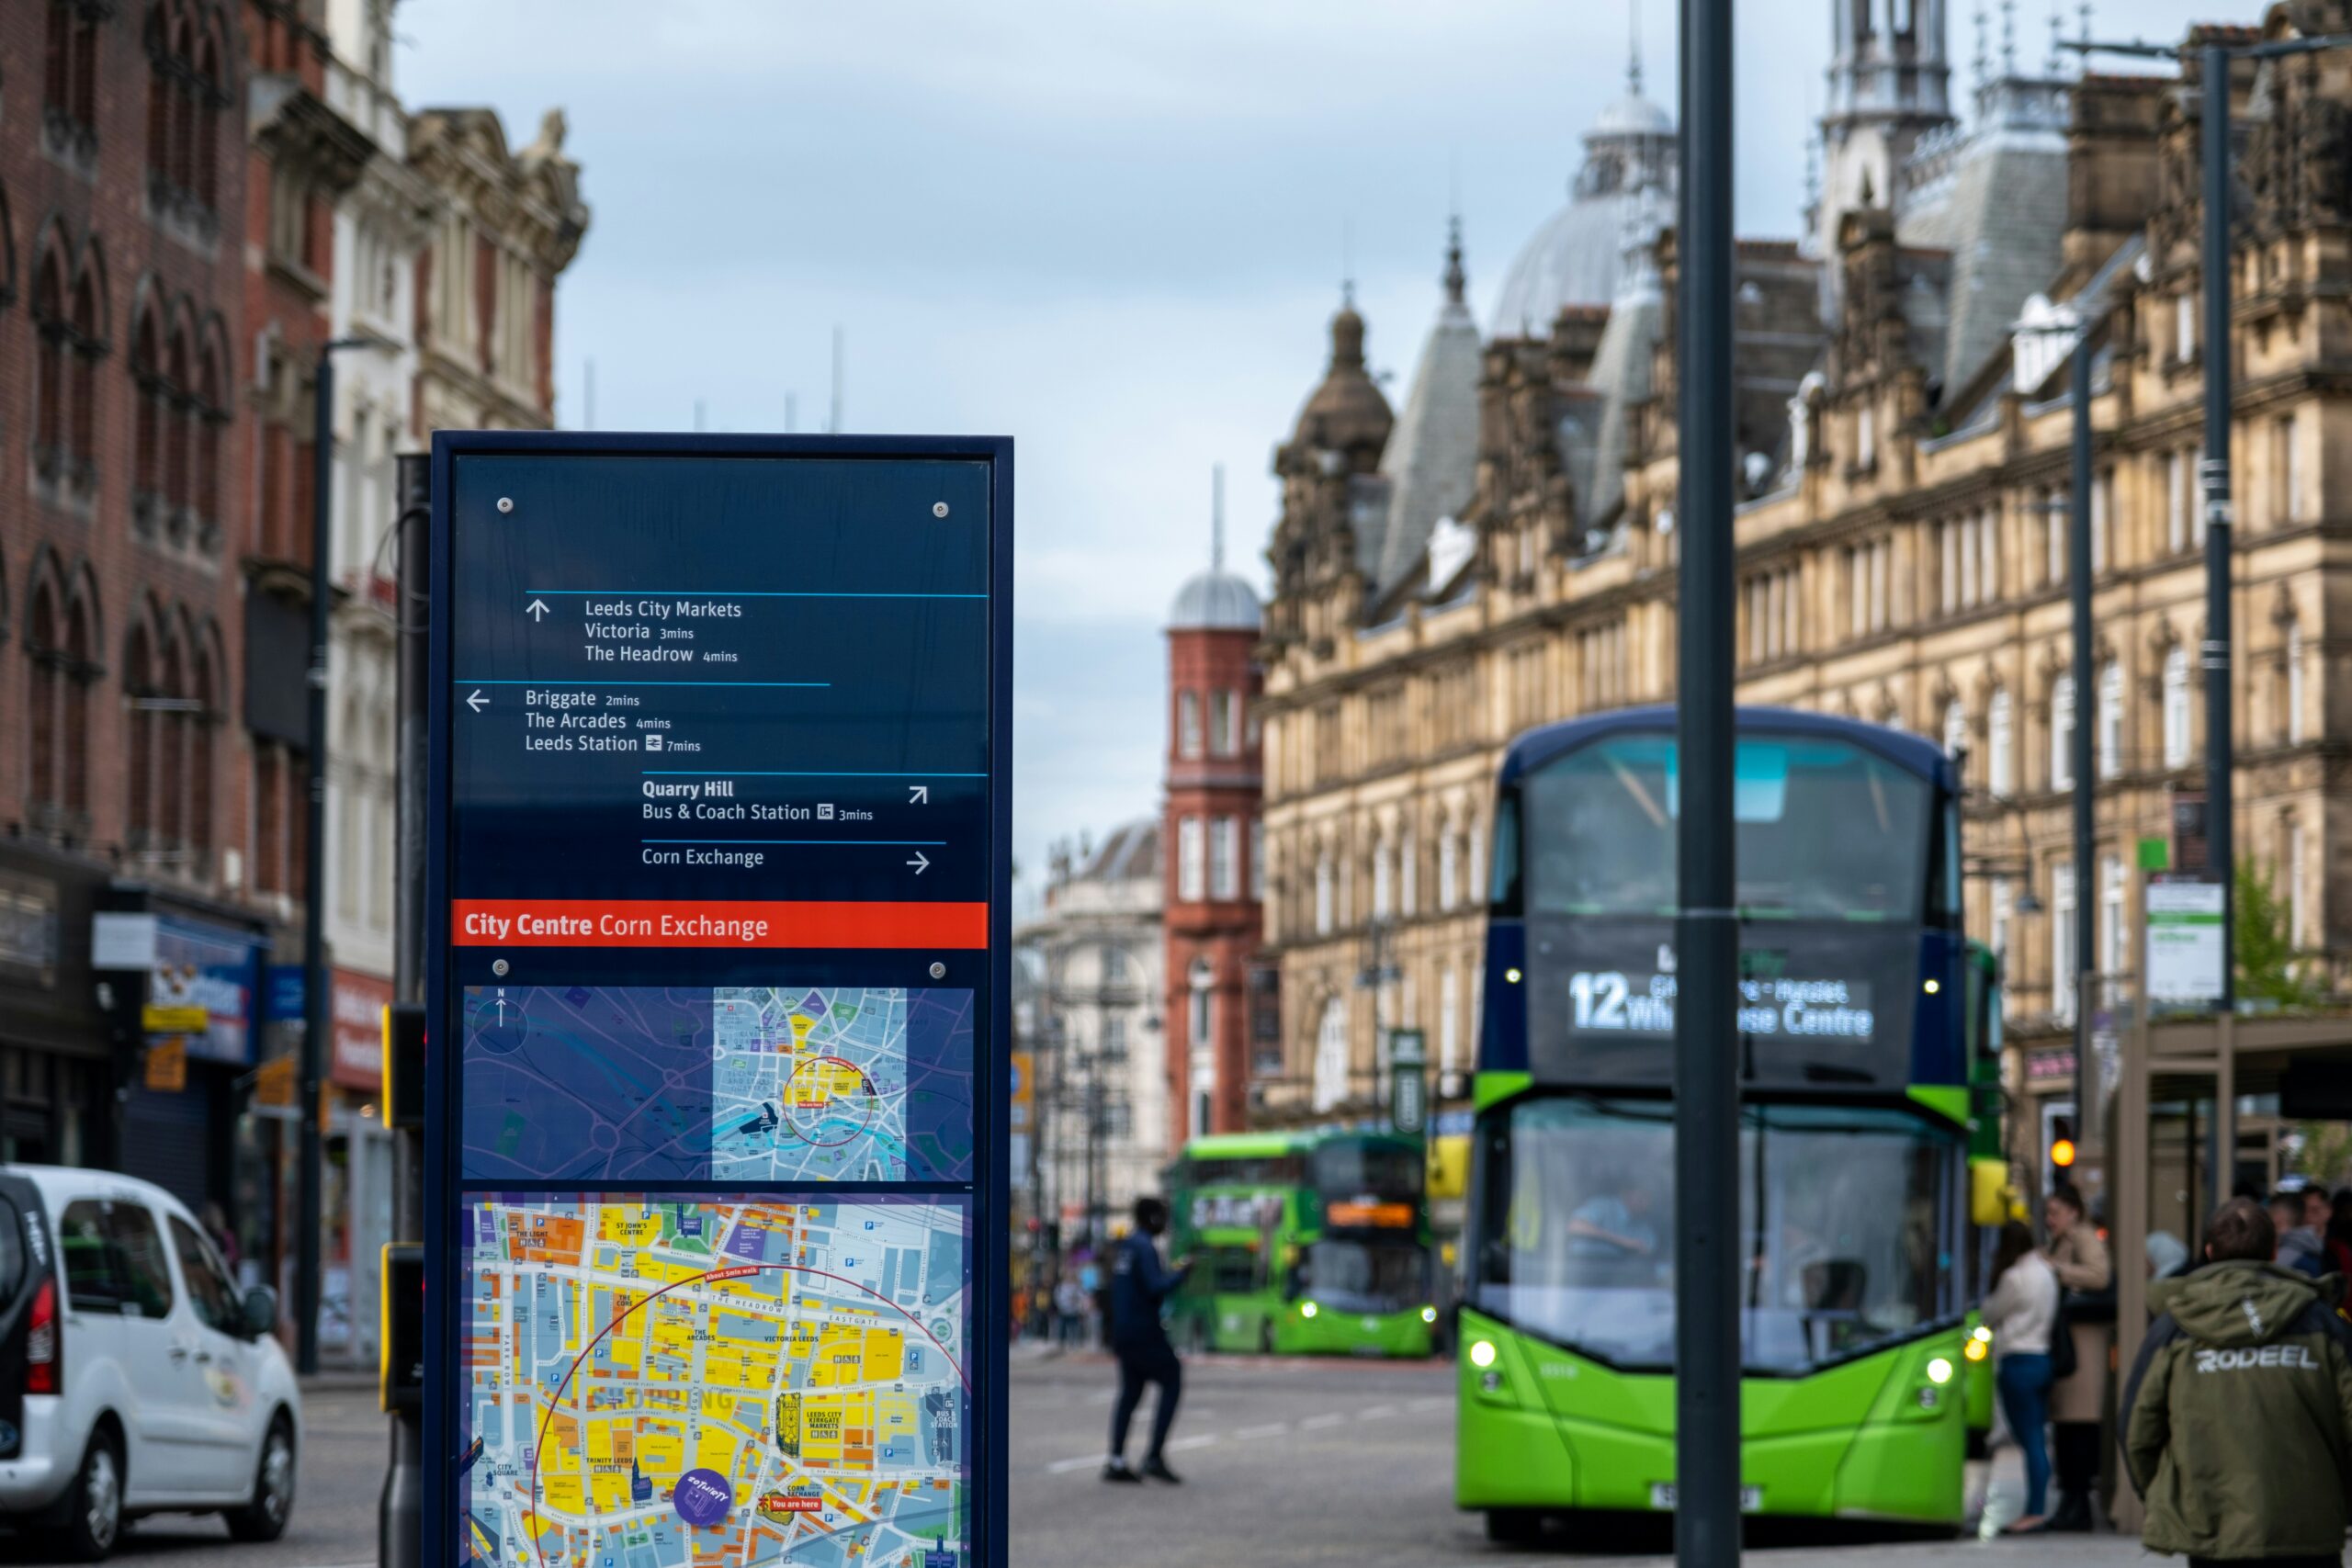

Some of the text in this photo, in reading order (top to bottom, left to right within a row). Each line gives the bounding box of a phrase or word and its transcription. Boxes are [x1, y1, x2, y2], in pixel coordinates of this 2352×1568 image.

[585, 600, 741, 620] Leeds City Markets
[585, 623, 694, 640] Victoria 3mins
[585, 645, 738, 663] The Headrow 4mins
[526, 690, 639, 709] Briggate 2mins
[526, 713, 671, 729] The Arcades 4mins
[526, 735, 701, 752] Leeds Station 7mins
[642, 781, 733, 800] Quarry Hill
[642, 804, 873, 821] Bus & Coach Station 3mins
[642, 849, 764, 868] Corn Exchange
[465, 914, 769, 942] City Centre Corn Exchange
[497, 988, 504, 998] N
[1570, 971, 1630, 1029] 12
[706, 1271, 724, 1281] About
[725, 1269, 741, 1278] 5min
[712, 1295, 783, 1314] THE HEADROW
[829, 1315, 878, 1326] EASTGATE
[2194, 1345, 2320, 1373] RODEEL
[593, 1388, 732, 1410] SHOPPING
[690, 1380, 700, 1429] BRIGGATE
